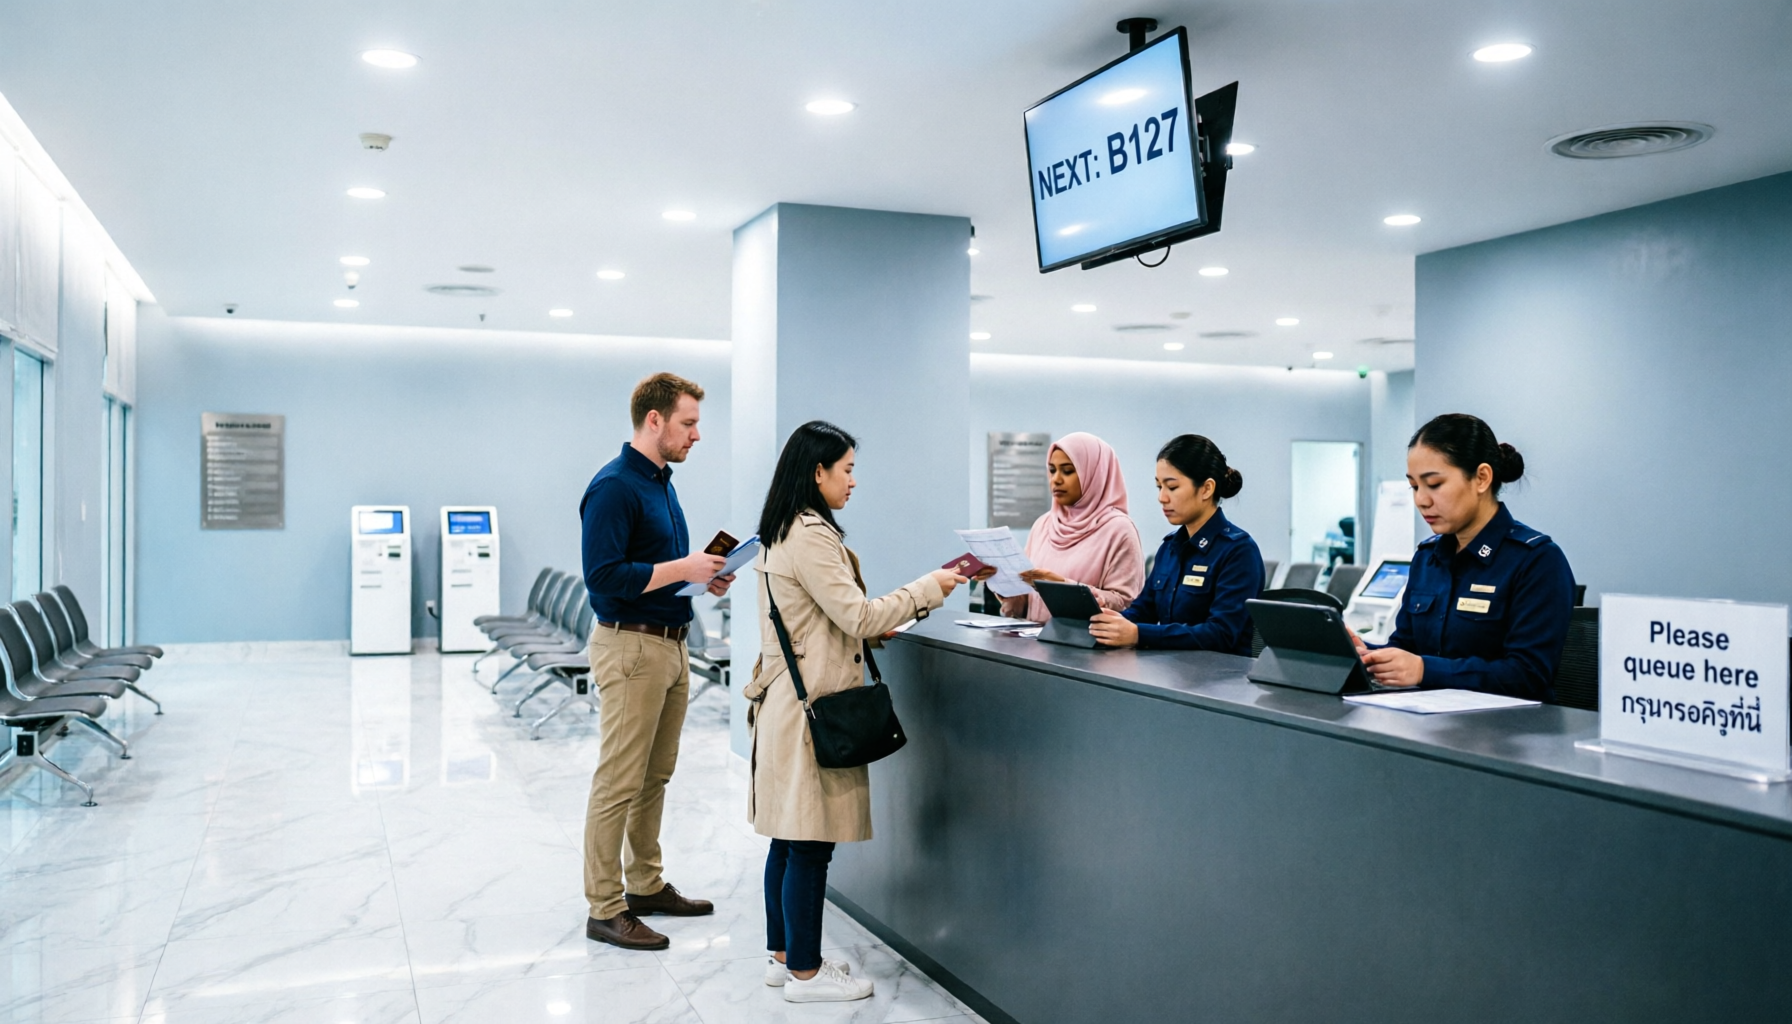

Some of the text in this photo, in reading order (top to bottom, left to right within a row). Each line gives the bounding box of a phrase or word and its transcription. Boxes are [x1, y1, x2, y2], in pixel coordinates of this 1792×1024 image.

[1038, 107, 1179, 200] NEXT: B127
[1650, 620, 1730, 651] Please
[1623, 656, 1759, 688] queue here
